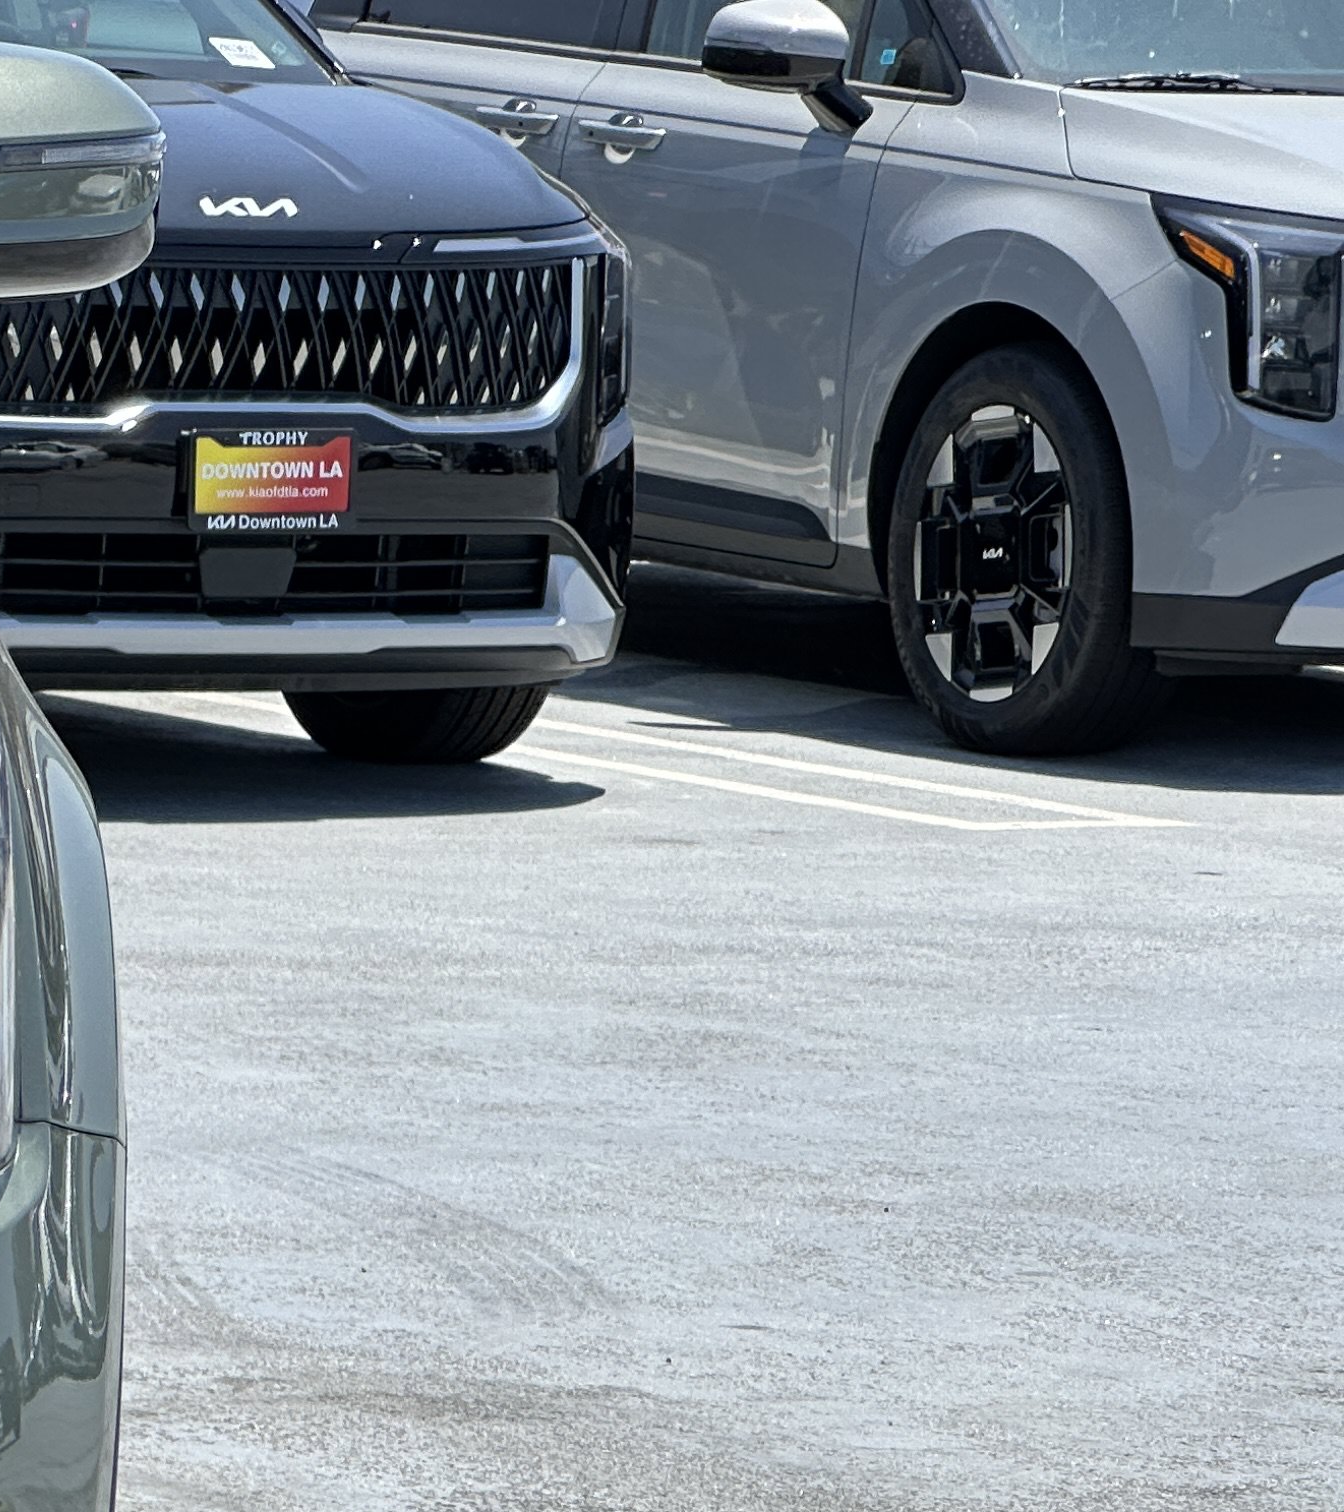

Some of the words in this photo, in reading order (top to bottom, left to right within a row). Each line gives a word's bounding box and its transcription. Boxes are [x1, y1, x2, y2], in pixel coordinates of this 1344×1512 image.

[240, 431, 308, 445] TROPHY
[202, 462, 313, 479] DOWNTOWN
[319, 460, 343, 478] LA
[217, 485, 328, 498] www.kiaofdtla.com
[239, 515, 316, 529] Downtown
[319, 513, 338, 528] LA
